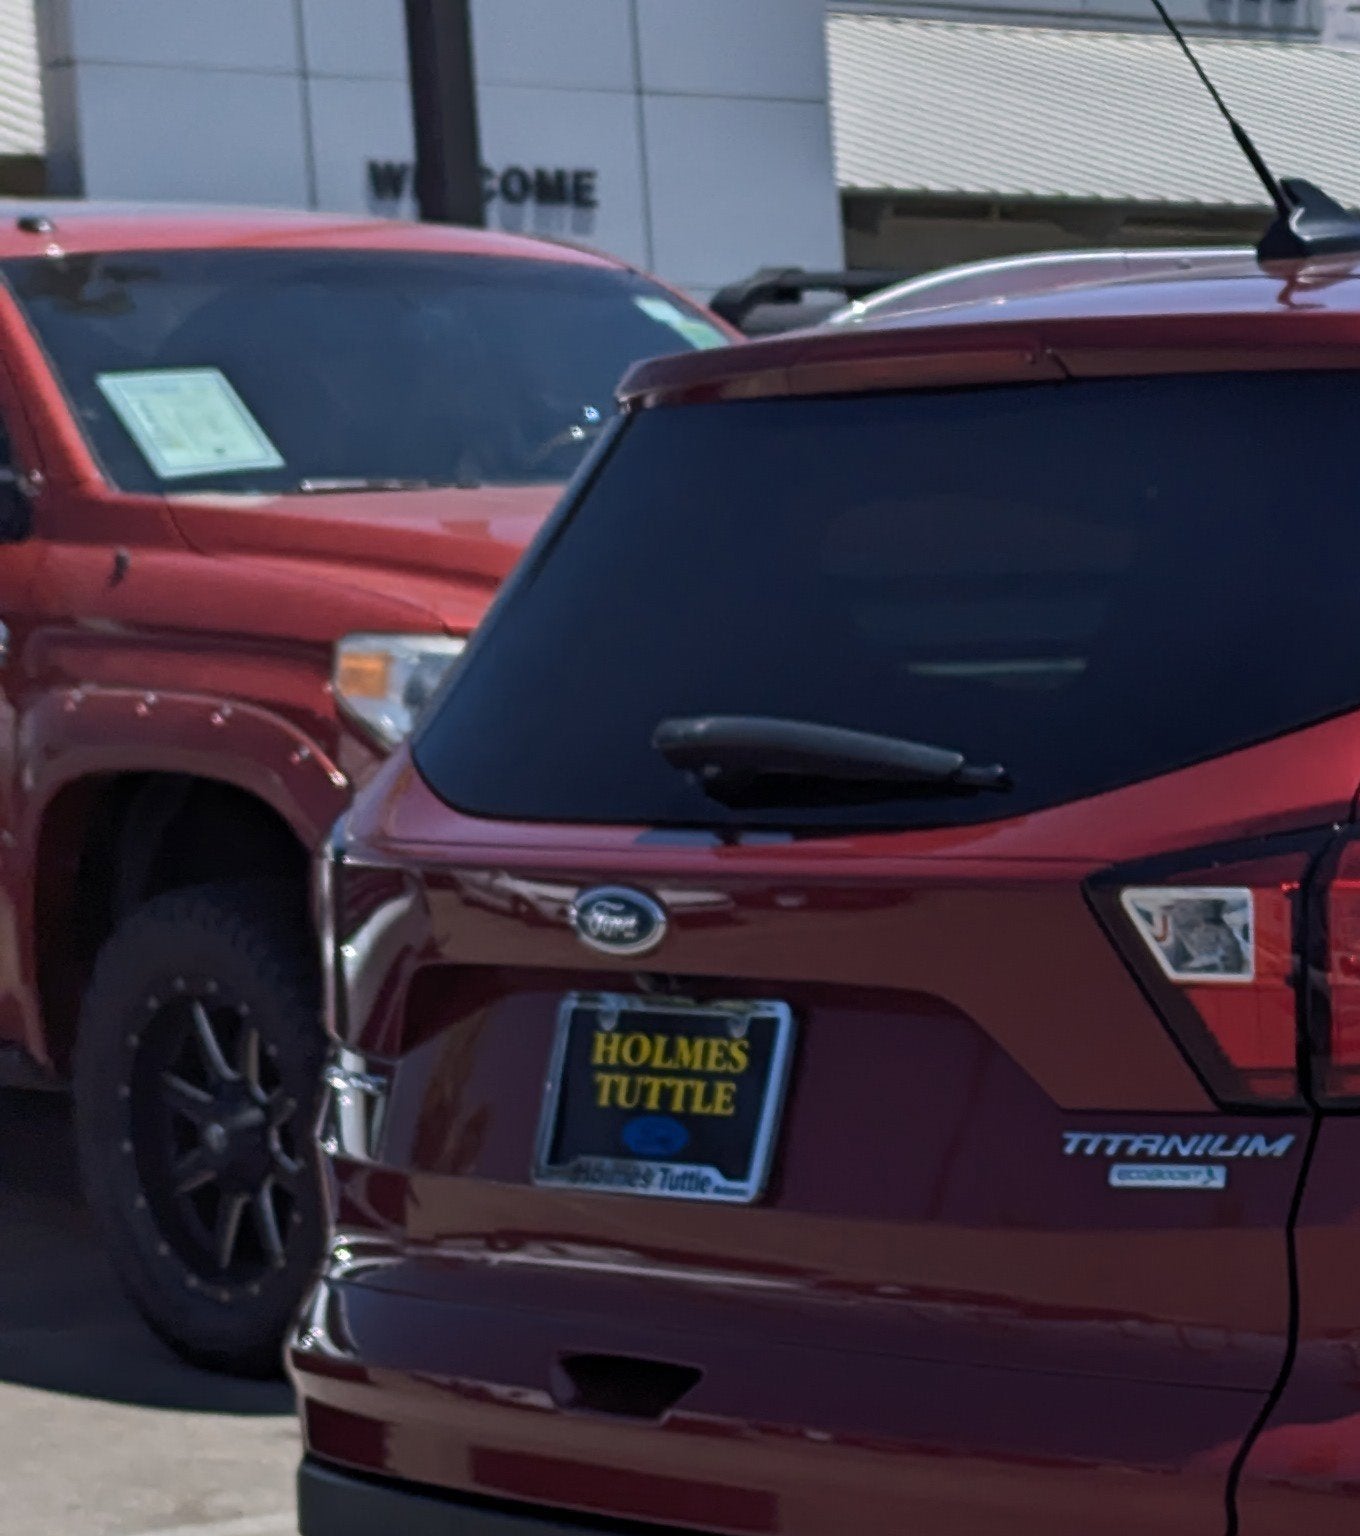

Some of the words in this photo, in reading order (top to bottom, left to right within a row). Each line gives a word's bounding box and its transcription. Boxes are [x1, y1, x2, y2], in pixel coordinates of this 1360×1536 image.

[366, 160, 598, 208] WCOME
[592, 1032, 750, 1074] HOLMES
[595, 1073, 737, 1116] TUTTLE
[1062, 1132, 1296, 1157] TITANIUM
